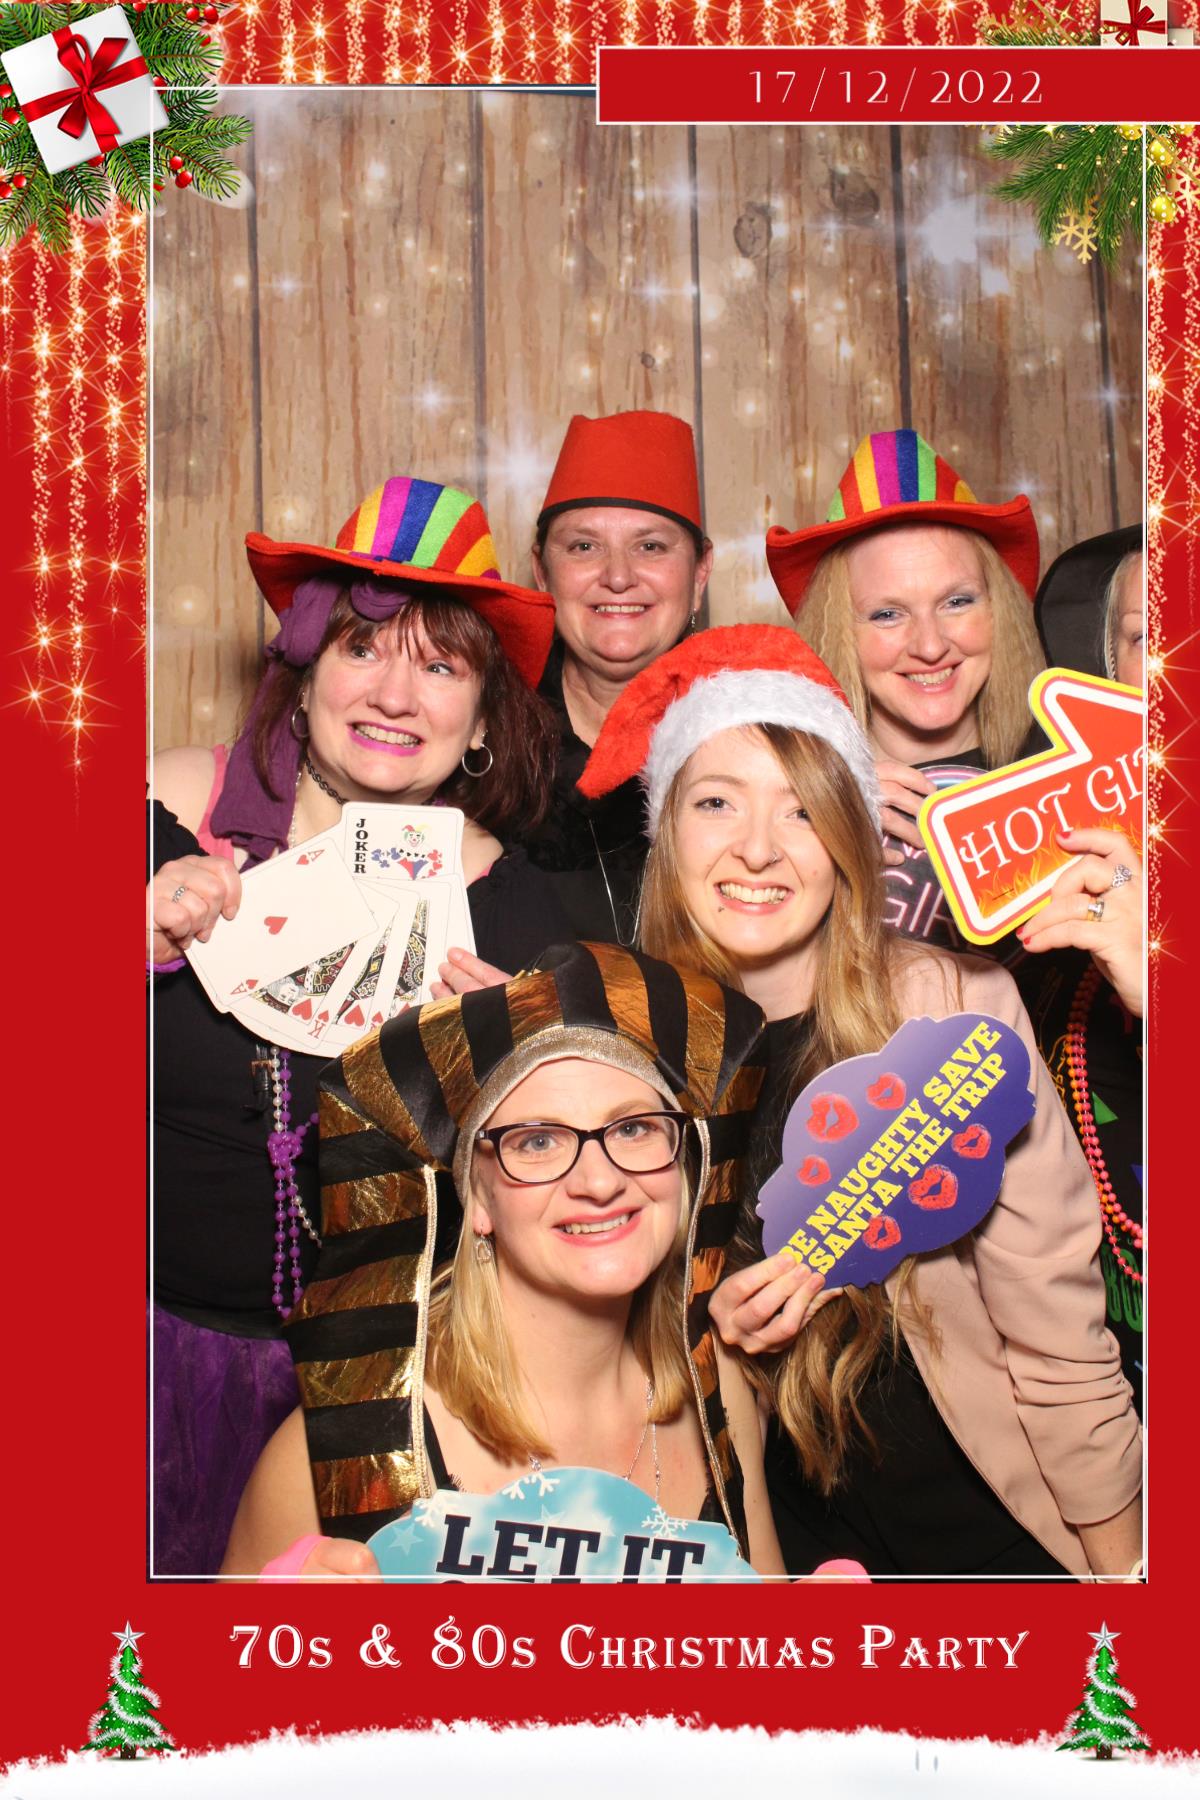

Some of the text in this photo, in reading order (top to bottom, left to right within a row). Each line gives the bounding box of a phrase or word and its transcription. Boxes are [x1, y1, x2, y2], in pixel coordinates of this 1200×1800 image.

[353, 818, 367, 874] JOKER
[959, 782, 1075, 879] HOT
[806, 1098, 930, 1236] NAUGHTY
[923, 1021, 1002, 1106] SAVE
[808, 1053, 1007, 1276] SANTA THE TRIP
[436, 1514, 706, 1584] LET IT
